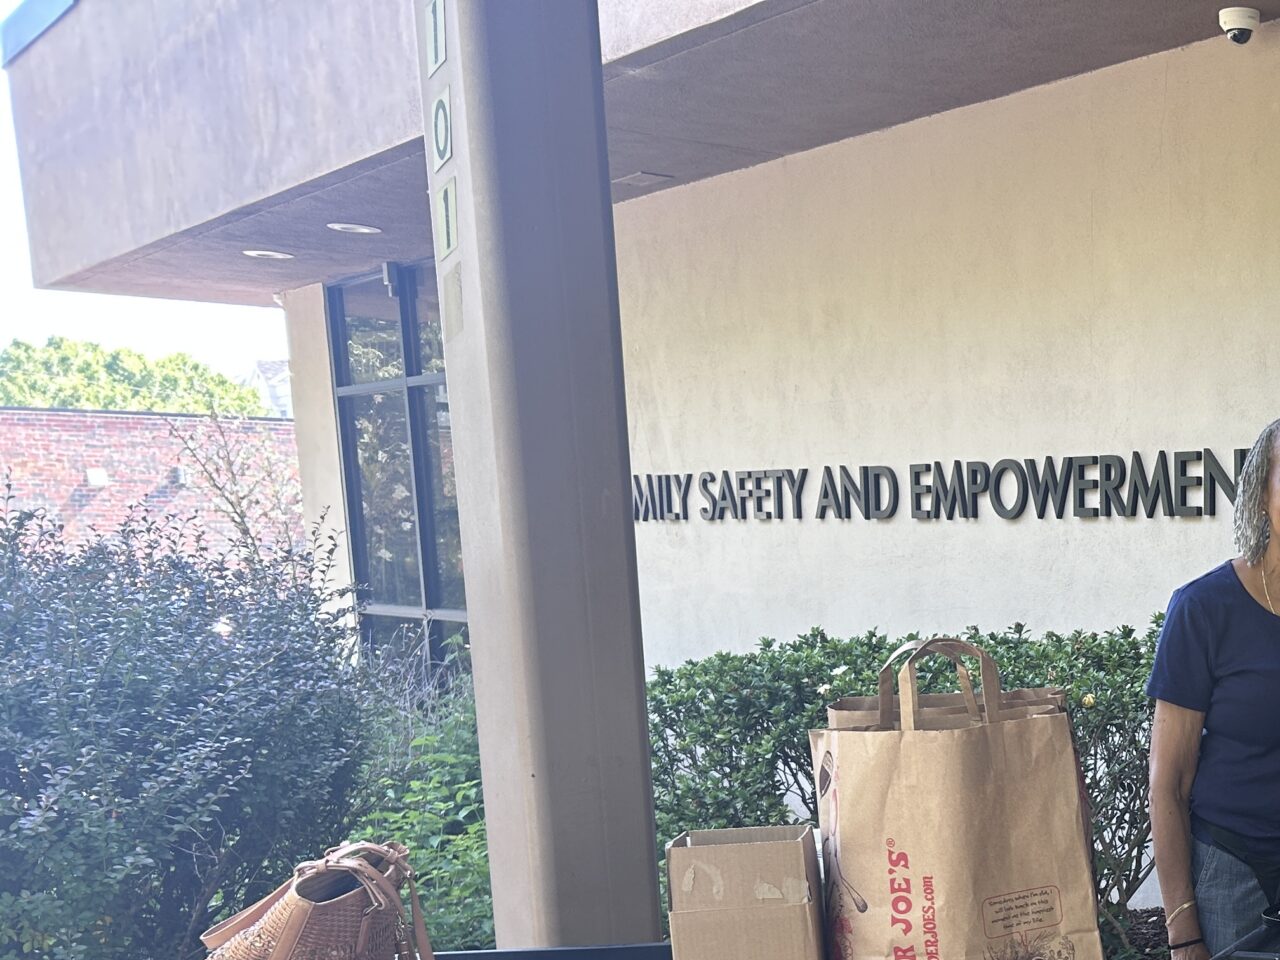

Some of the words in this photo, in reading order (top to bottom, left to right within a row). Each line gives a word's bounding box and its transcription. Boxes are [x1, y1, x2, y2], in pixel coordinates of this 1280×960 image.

[700, 468, 808, 521] SAFETY
[816, 465, 899, 520] AND
[909, 447, 1241, 521] EMPOWERMEN
